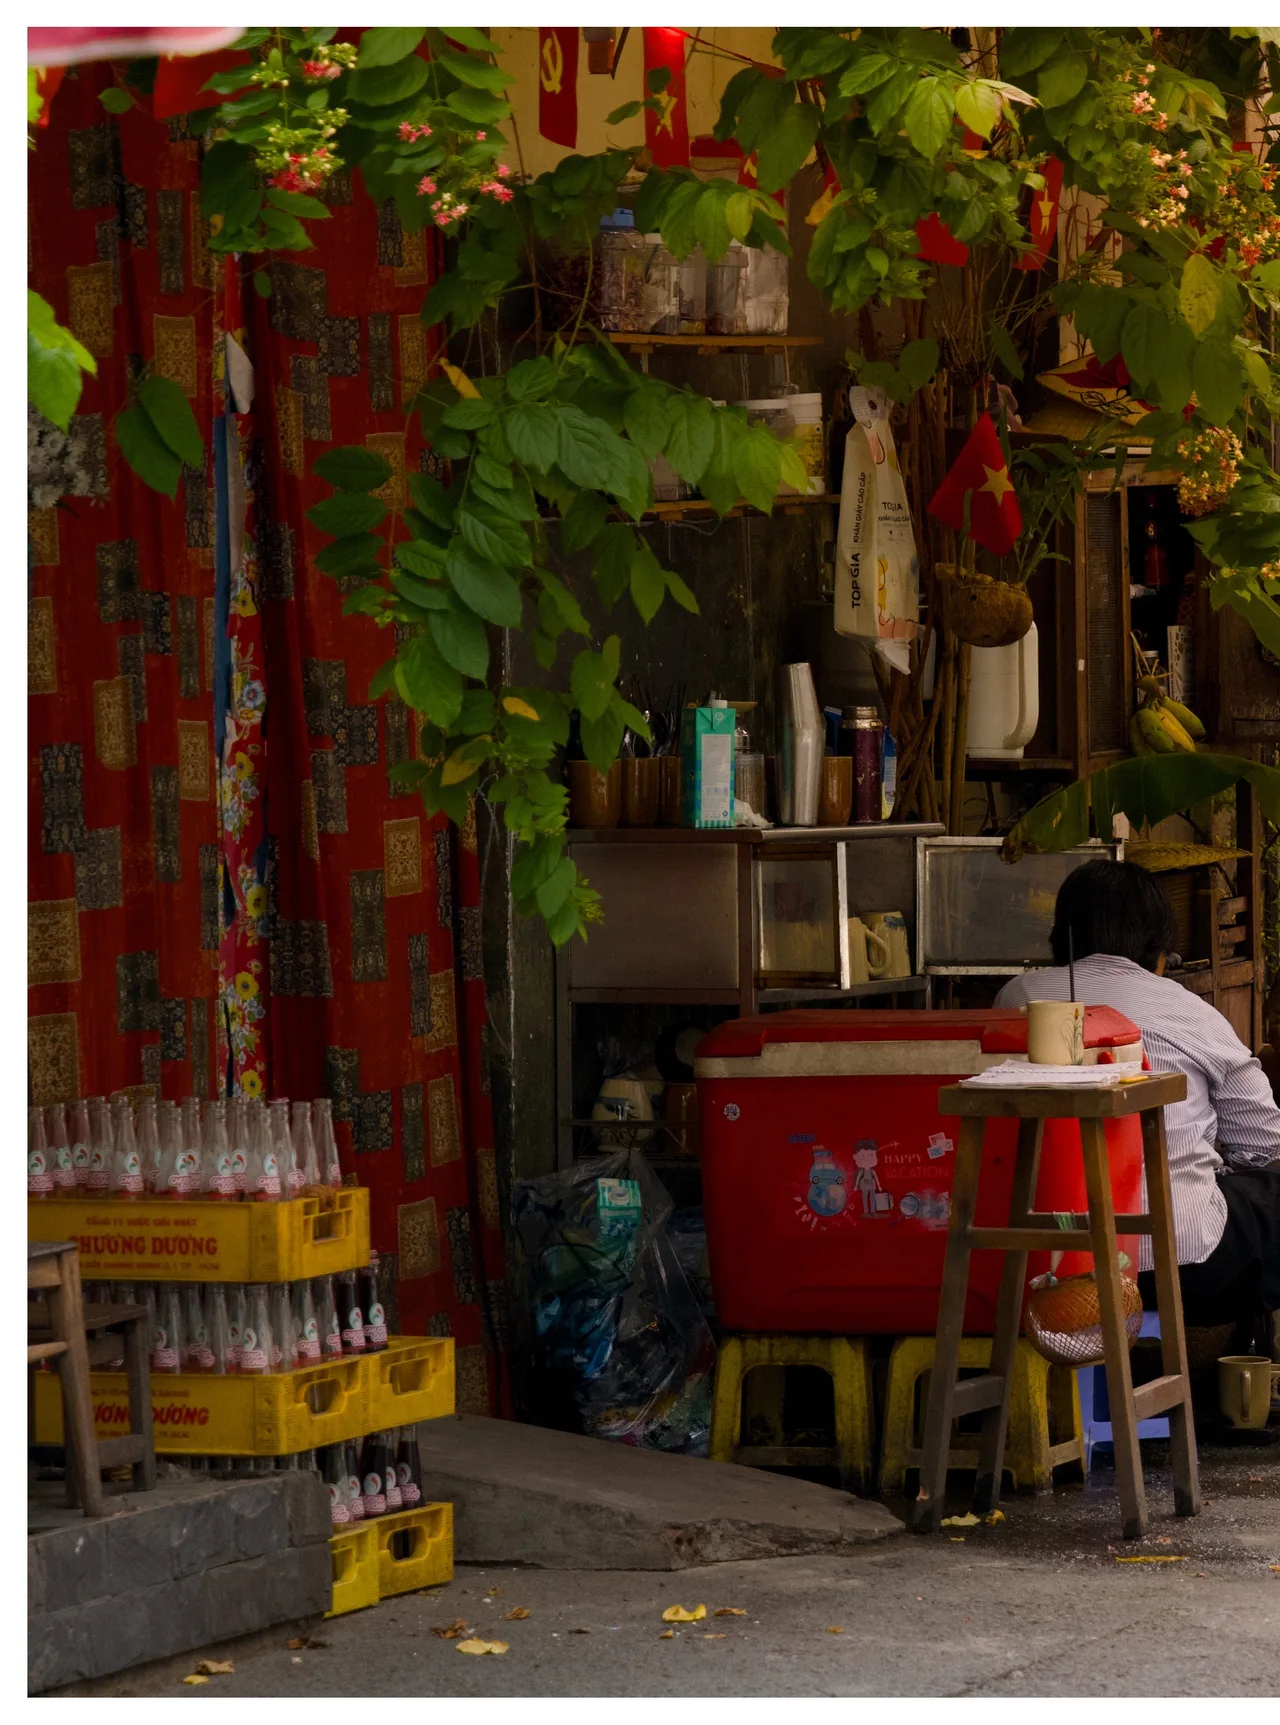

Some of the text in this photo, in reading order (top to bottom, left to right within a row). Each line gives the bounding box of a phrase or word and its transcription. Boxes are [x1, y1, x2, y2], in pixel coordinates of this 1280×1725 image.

[851, 553, 860, 577] GIA
[852, 580, 861, 608] TOP
[884, 1154, 922, 1163] HAPPY
[884, 1165, 948, 1178] VACATION
[151, 1233, 217, 1255] DƯƠNG
